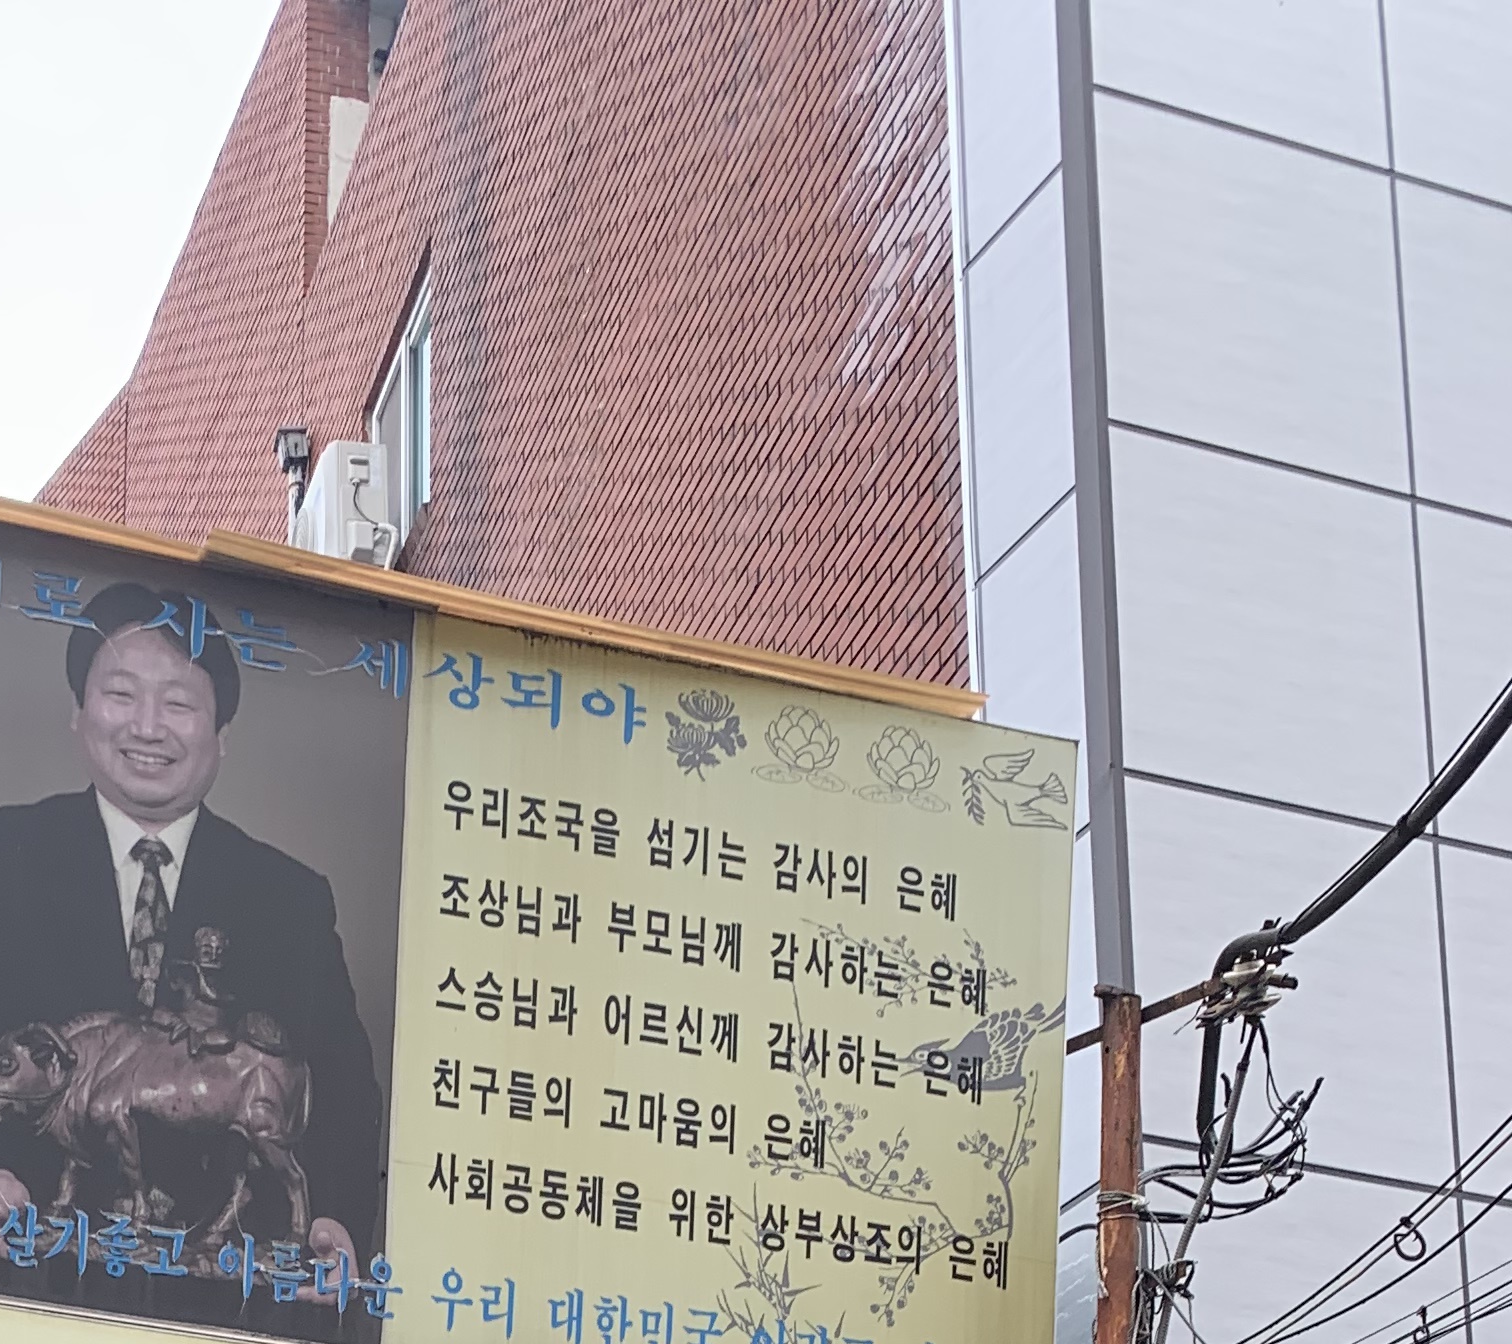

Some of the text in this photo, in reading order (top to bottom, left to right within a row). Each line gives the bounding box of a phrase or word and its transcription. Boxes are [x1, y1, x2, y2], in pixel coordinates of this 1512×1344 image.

[140, 596, 298, 672] 사는
[342, 639, 648, 746] 세상되야
[443, 780, 958, 922] 우리조국을 섬기는 감사의 은혜
[439, 873, 987, 1017] 조상님과 부모님께 감사하는 은혜
[435, 966, 983, 1105] 스승님과 어르신께 감사하는 은혜
[432, 1058, 826, 1168] 친구들의 고마움의 은혜
[427, 1152, 1008, 1290] 사회공동체을 위한 상부상조의 은혜
[431, 1268, 516, 1340] 우리
